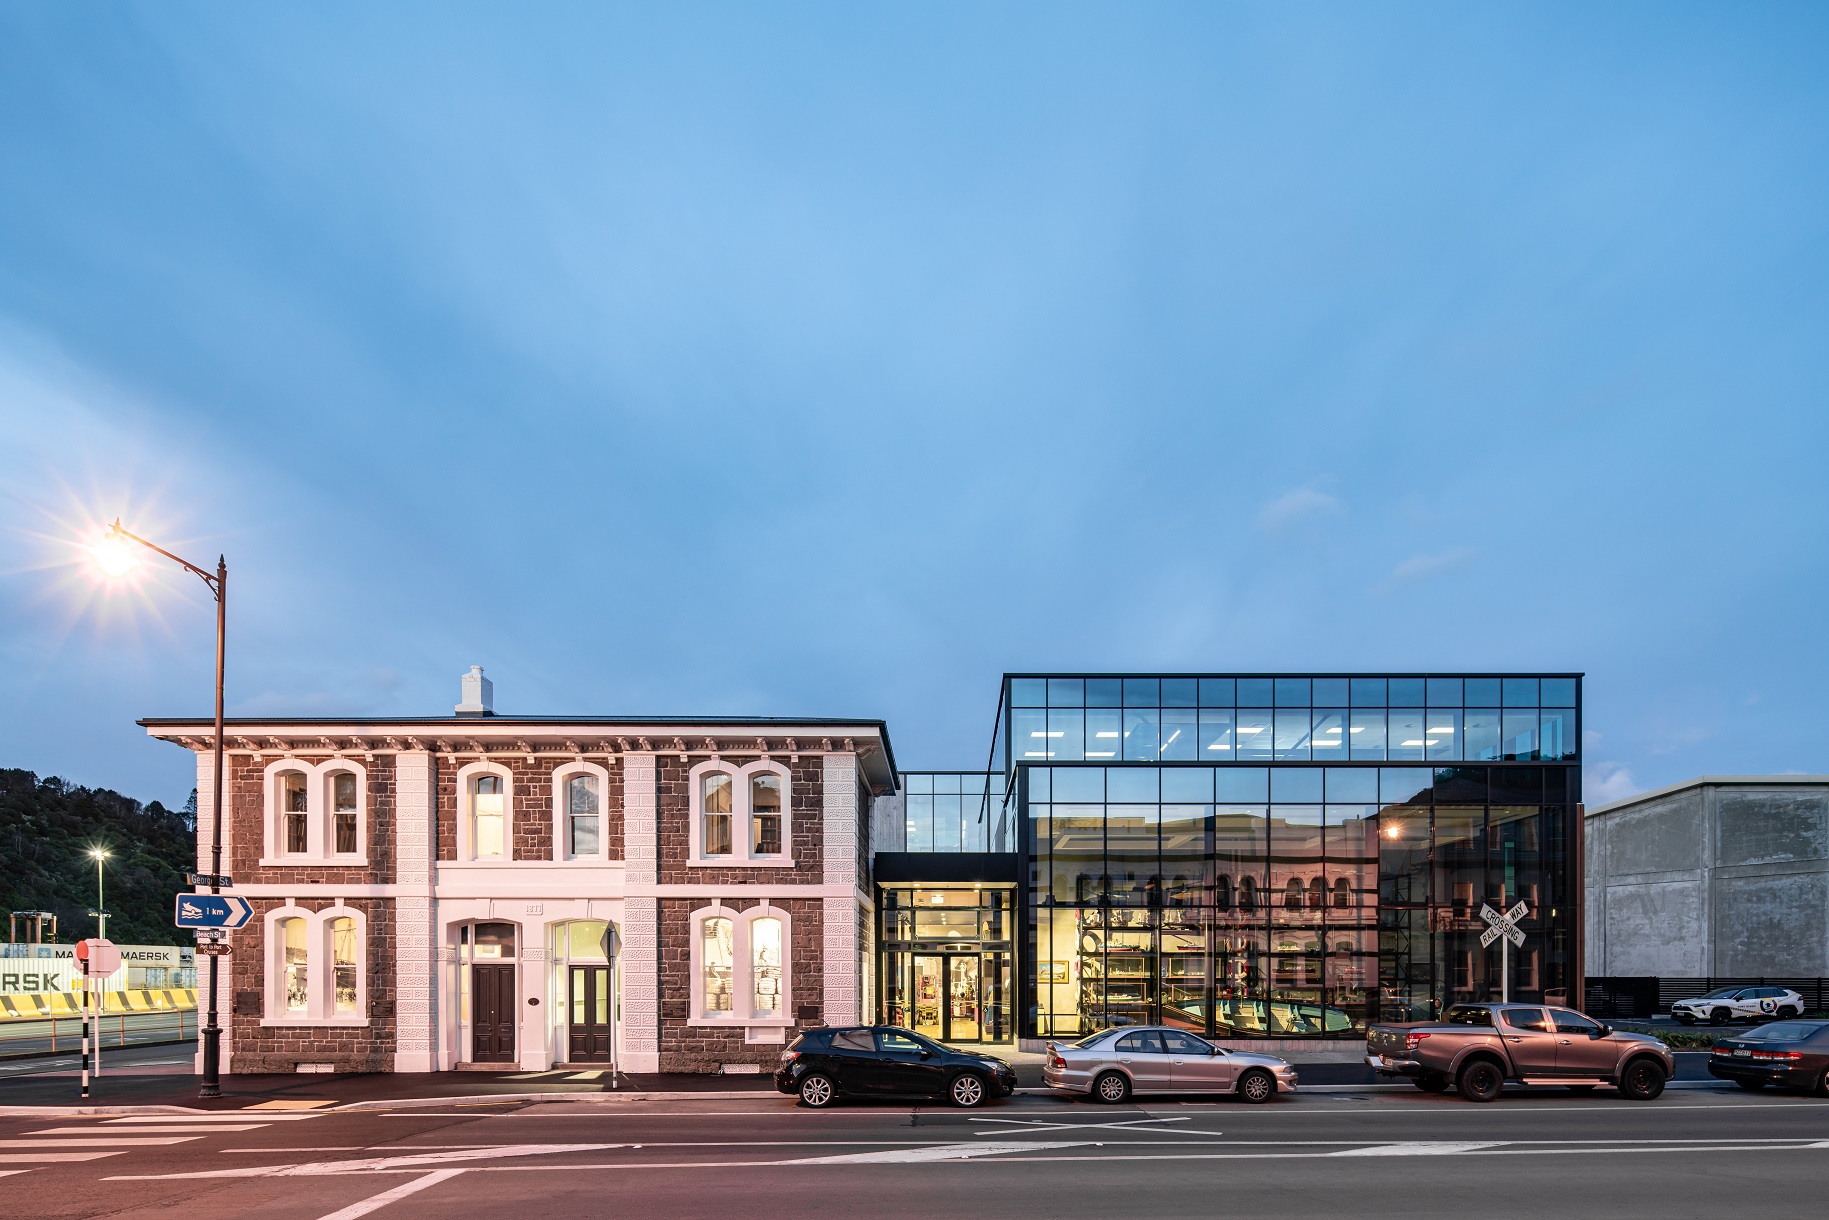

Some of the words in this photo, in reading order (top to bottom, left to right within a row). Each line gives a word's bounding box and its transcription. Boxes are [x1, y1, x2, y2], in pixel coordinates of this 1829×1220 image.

[191, 874, 213, 886] Georg
[219, 876, 229, 886] St
[206, 907, 210, 915] 1
[1482, 928, 1498, 945] RAIL
[1509, 903, 1524, 921] WAY
[1485, 910, 1520, 941] CROSSING
[196, 930, 214, 938] Beach
[121, 951, 170, 961] MAERSK
